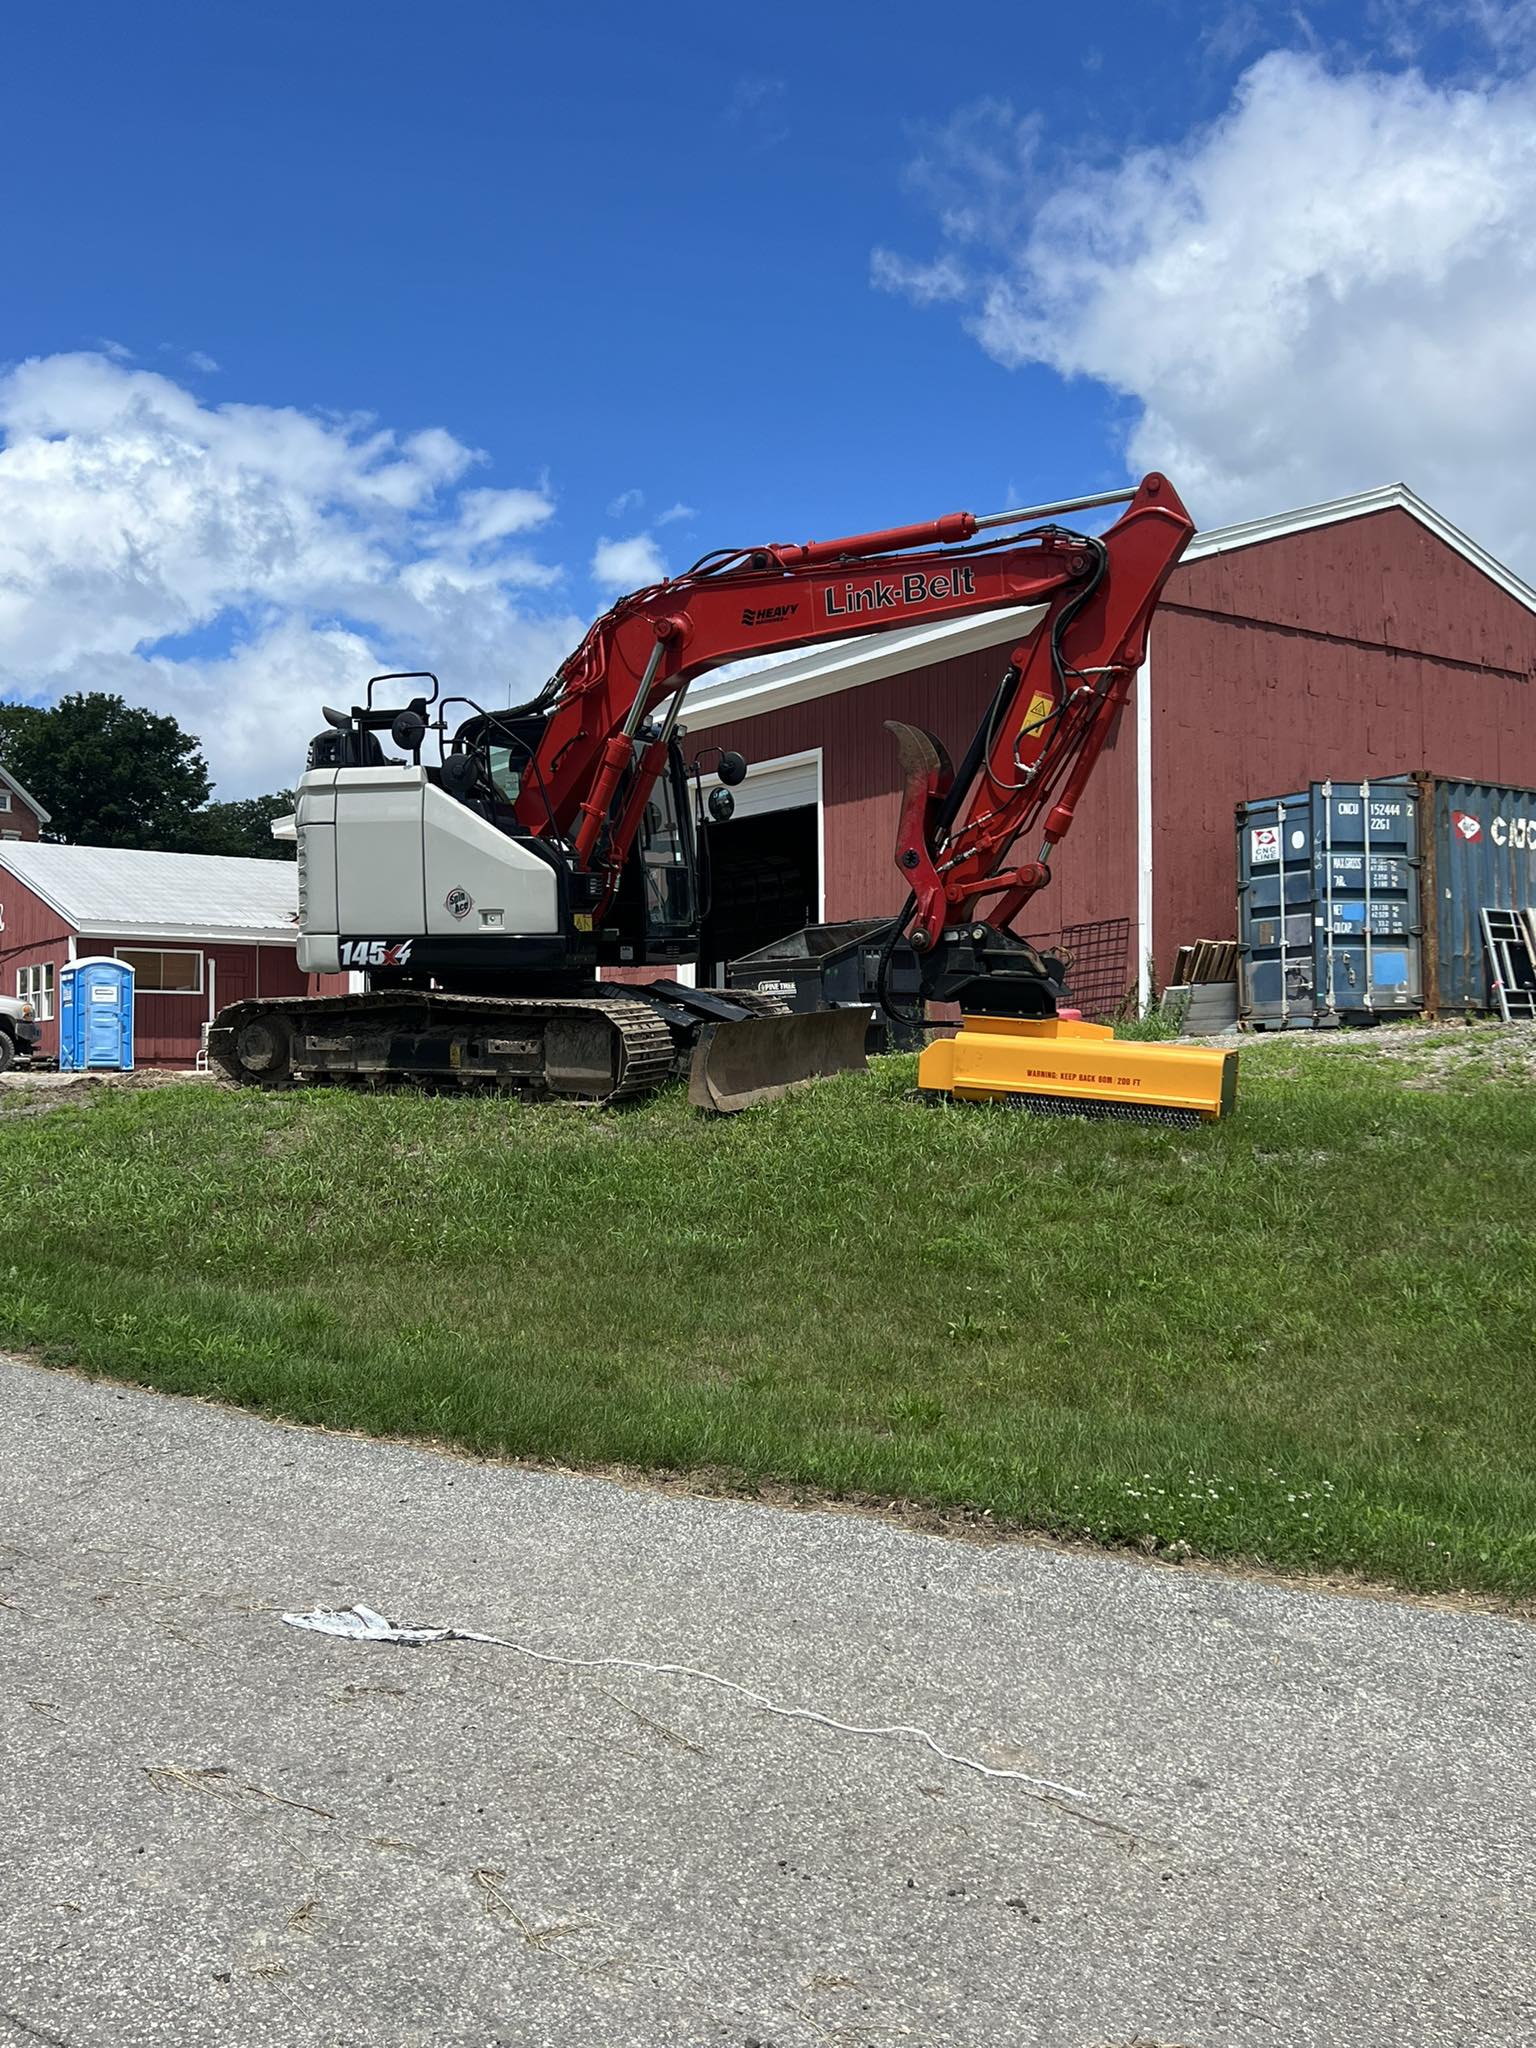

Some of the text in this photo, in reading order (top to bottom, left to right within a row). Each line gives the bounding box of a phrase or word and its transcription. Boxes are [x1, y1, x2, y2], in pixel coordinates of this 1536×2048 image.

[824, 566, 976, 617] Link-Belt
[757, 603, 799, 619] HEAVY
[1370, 803, 1400, 816] 152444
[1406, 804, 1414, 816] 2
[1255, 846, 1277, 855] CNC
[1255, 853, 1277, 861] LINE
[455, 902, 469, 913] Ace
[765, 982, 796, 991] PINE TREE
[1027, 1069, 1057, 1079] WARNING:
[1060, 1072, 1077, 1081] KEEP
[1079, 1073, 1096, 1082] BACK
[1132, 1079, 1141, 1087] FT
